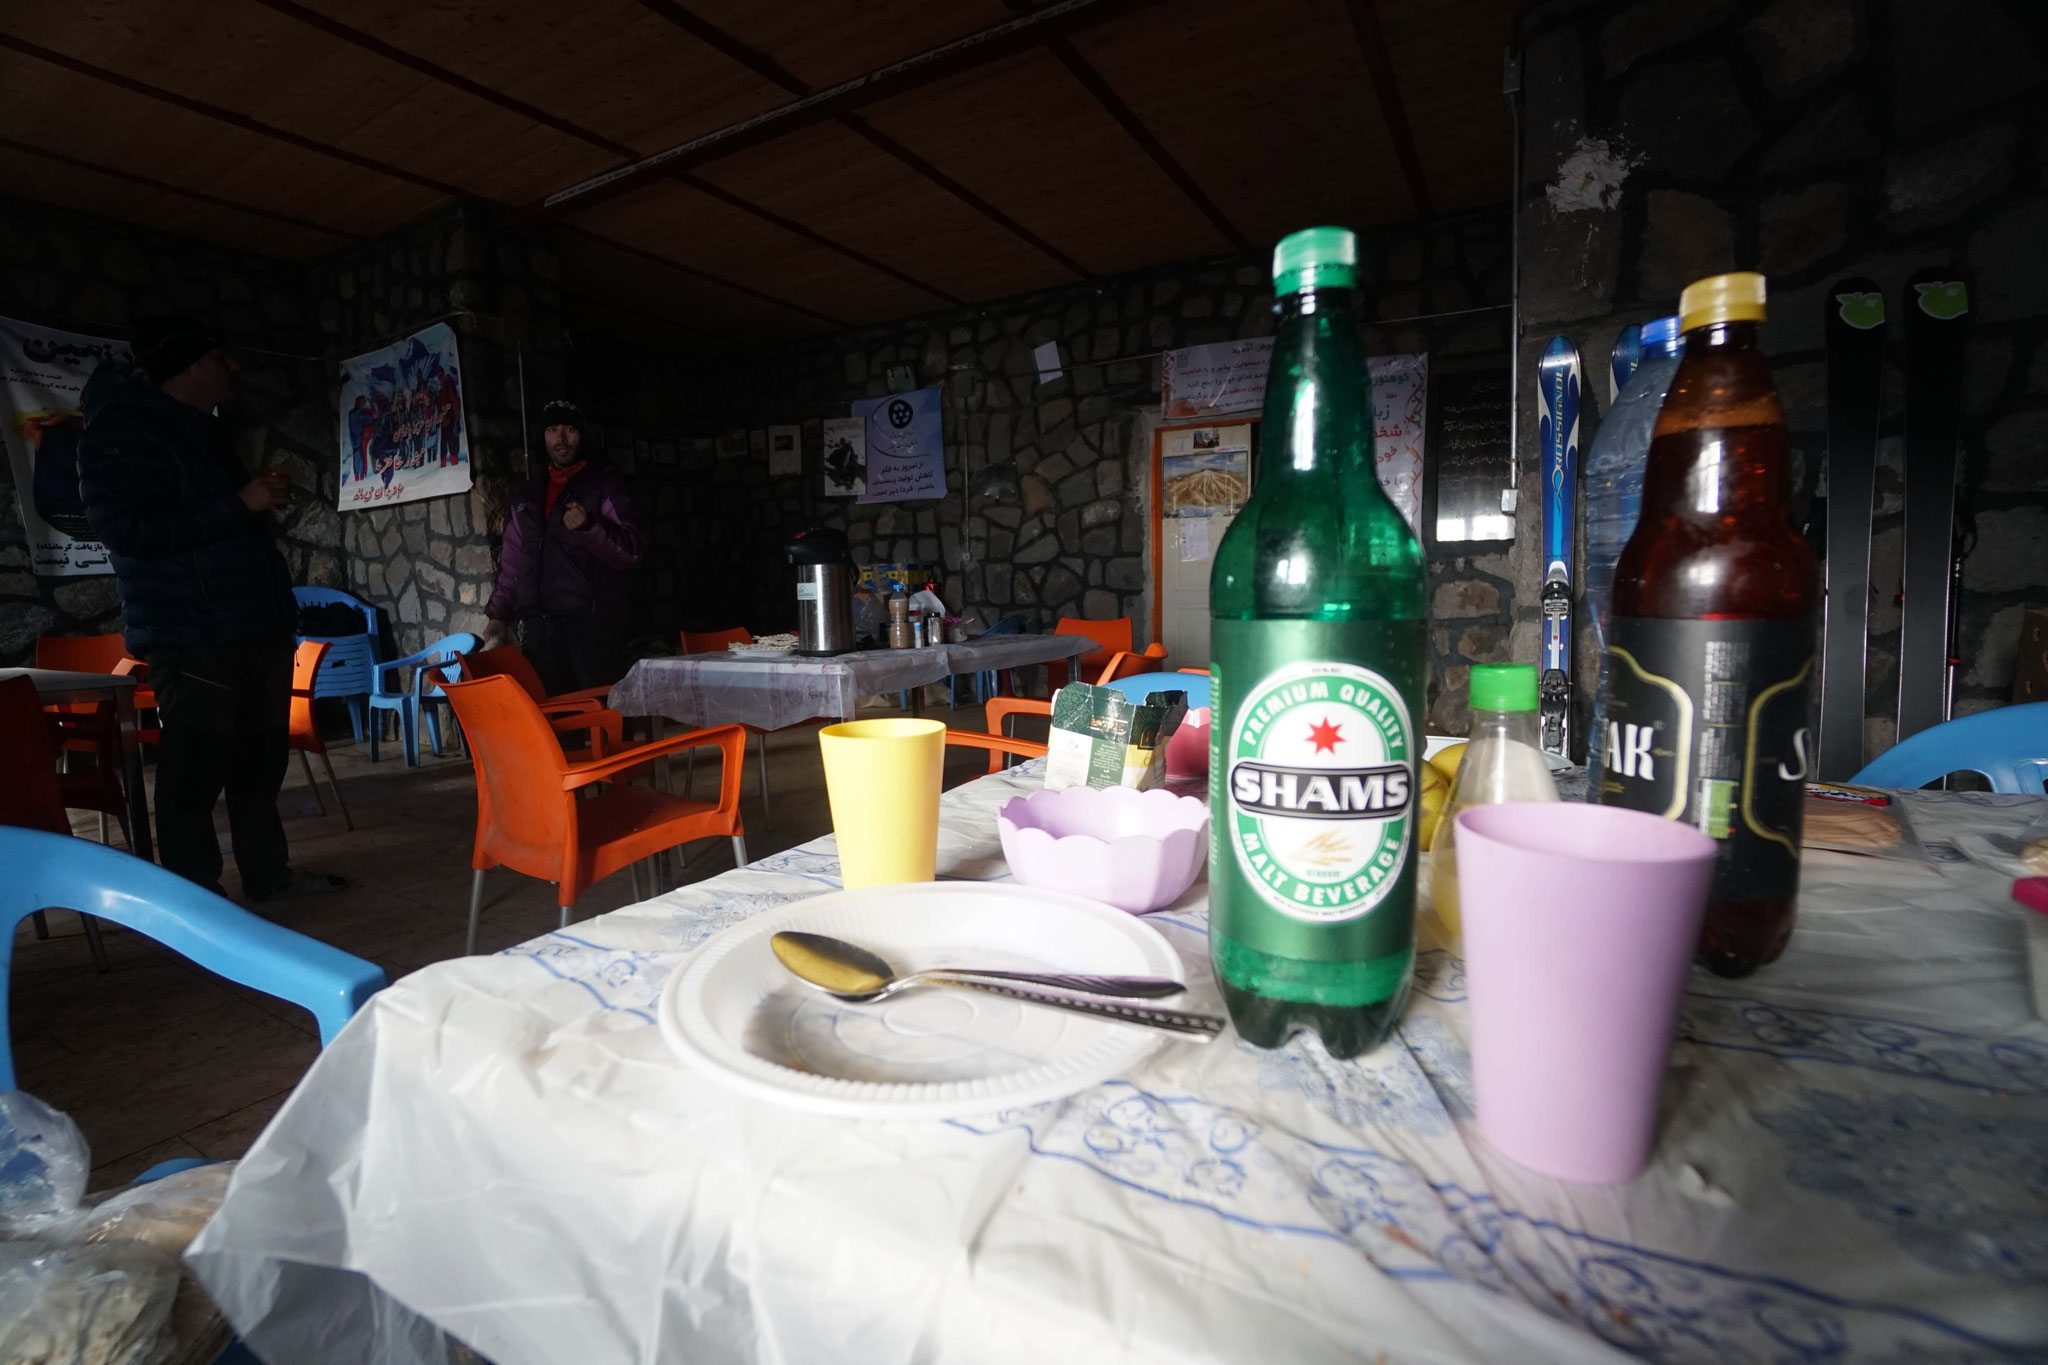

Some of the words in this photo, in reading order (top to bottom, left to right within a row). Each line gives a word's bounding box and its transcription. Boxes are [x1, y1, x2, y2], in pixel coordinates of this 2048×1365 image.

[1555, 368, 1564, 468] ROSSIGNOL
[1243, 681, 1329, 746] PREMIUM
[1339, 684, 1404, 748] QUALITY
[1234, 767, 1409, 811] SHAMS
[1242, 832, 1289, 888] MALT
[1293, 838, 1400, 906] BEVERAGE
